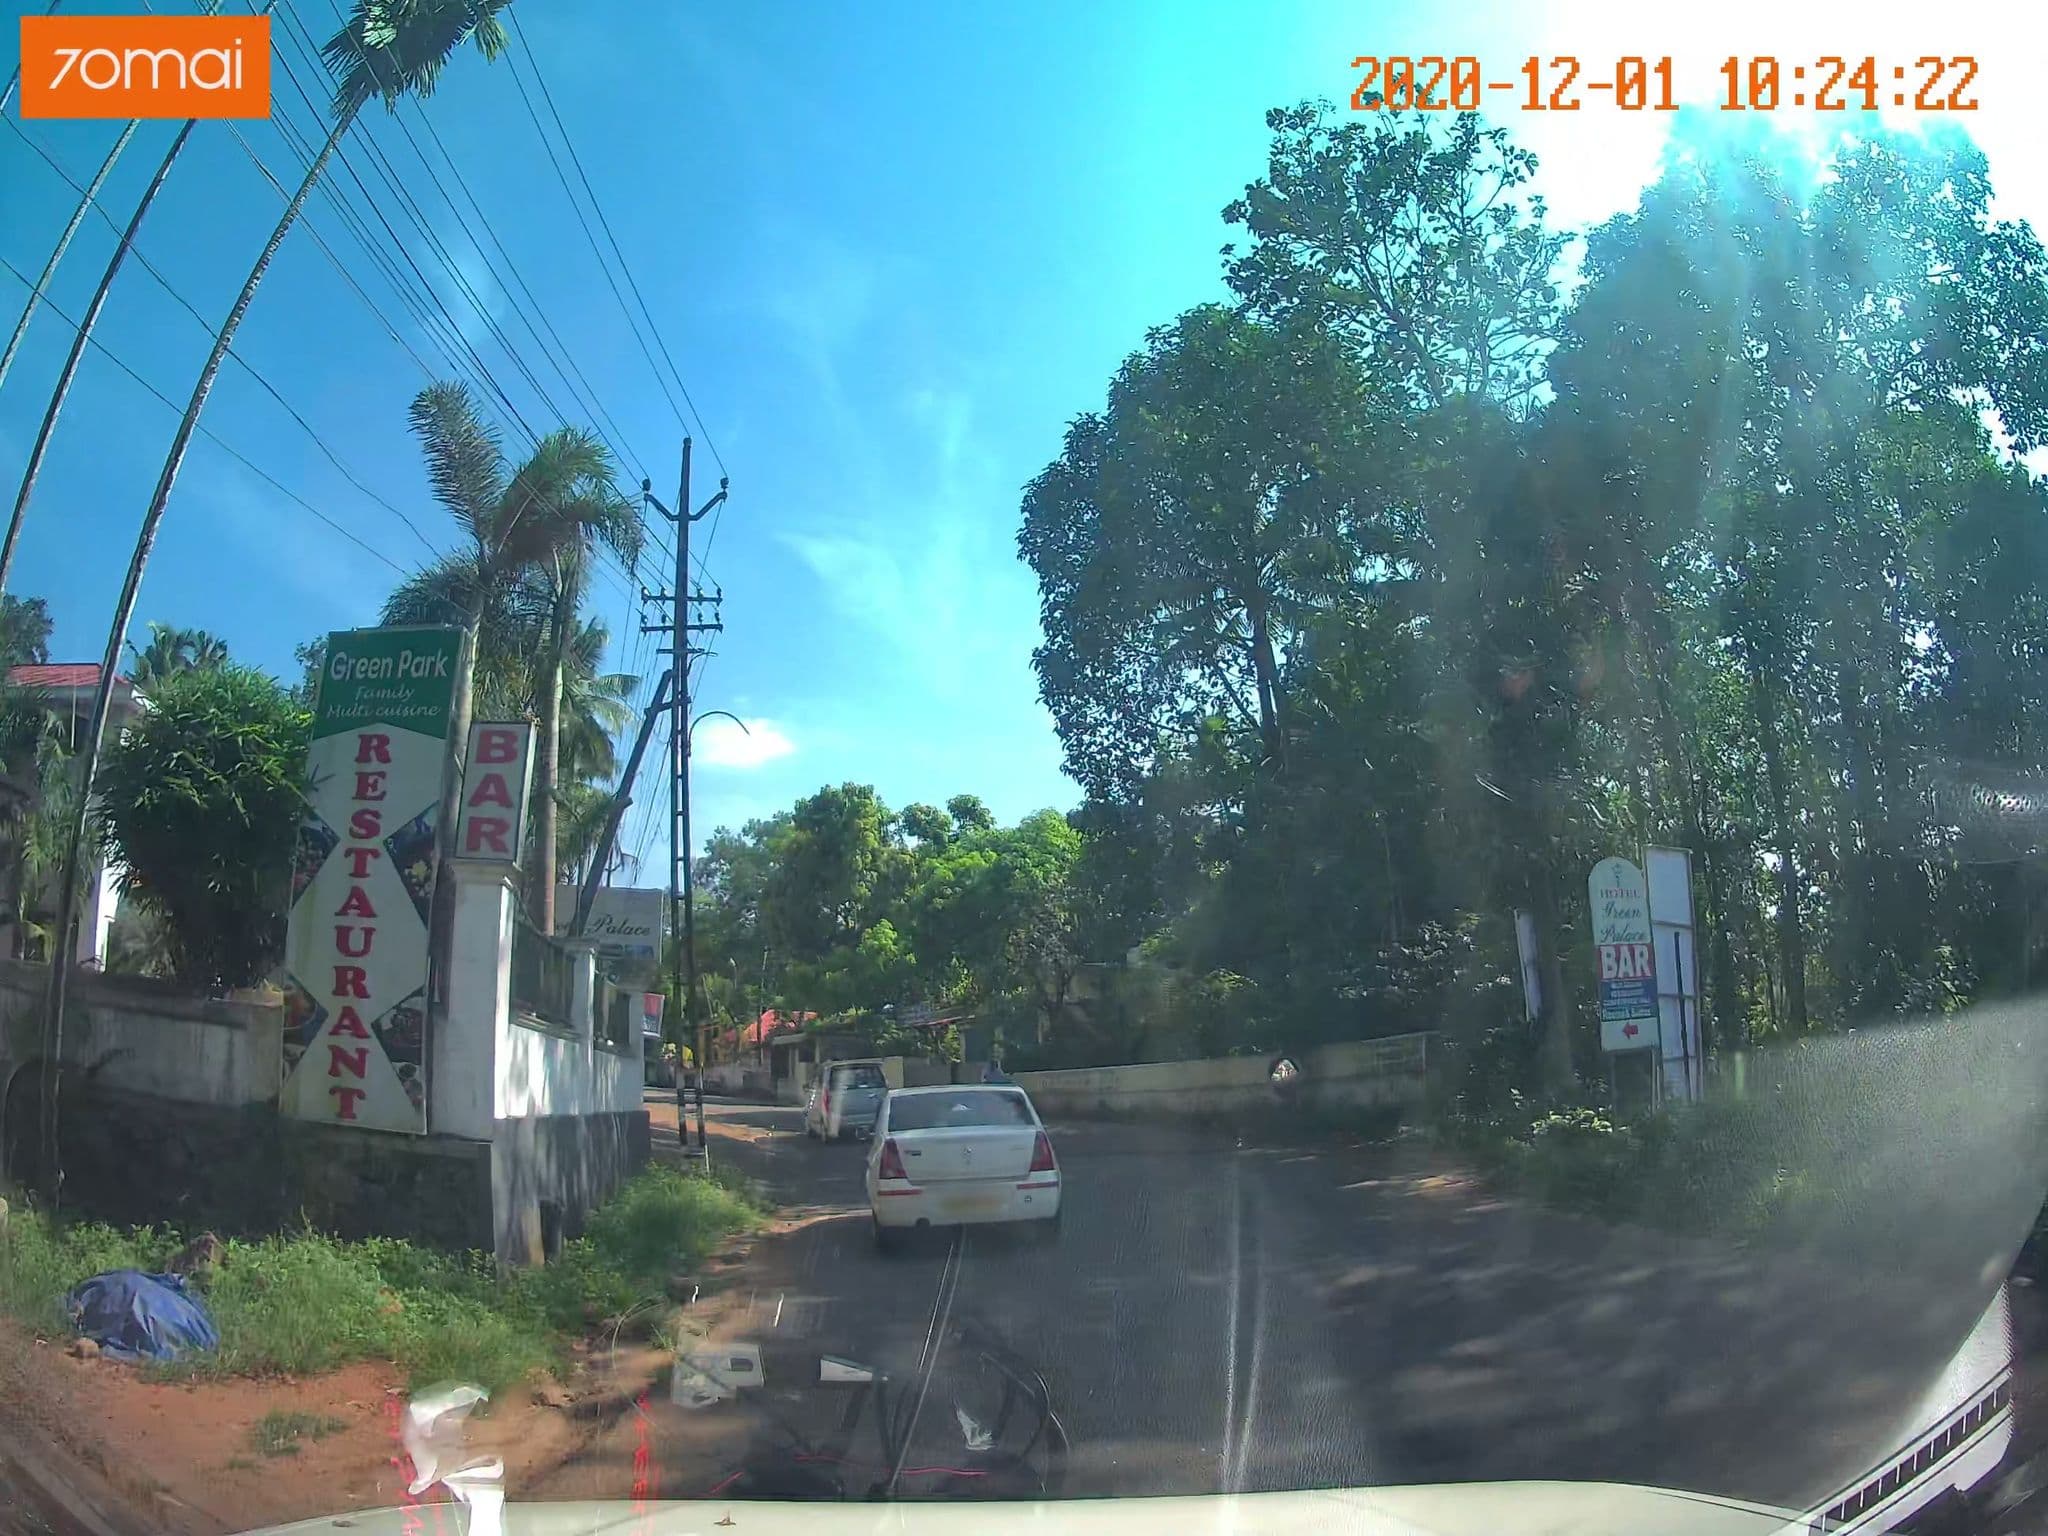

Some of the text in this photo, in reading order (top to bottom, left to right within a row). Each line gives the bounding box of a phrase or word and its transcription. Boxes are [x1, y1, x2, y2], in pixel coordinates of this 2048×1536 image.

[330, 648, 449, 682] Green Park
[375, 703, 441, 718] cuisine
[464, 729, 519, 854] BAR
[326, 733, 392, 1121] RESTAURANT
[591, 912, 652, 937] Palace
[1600, 945, 1653, 979] BAR
